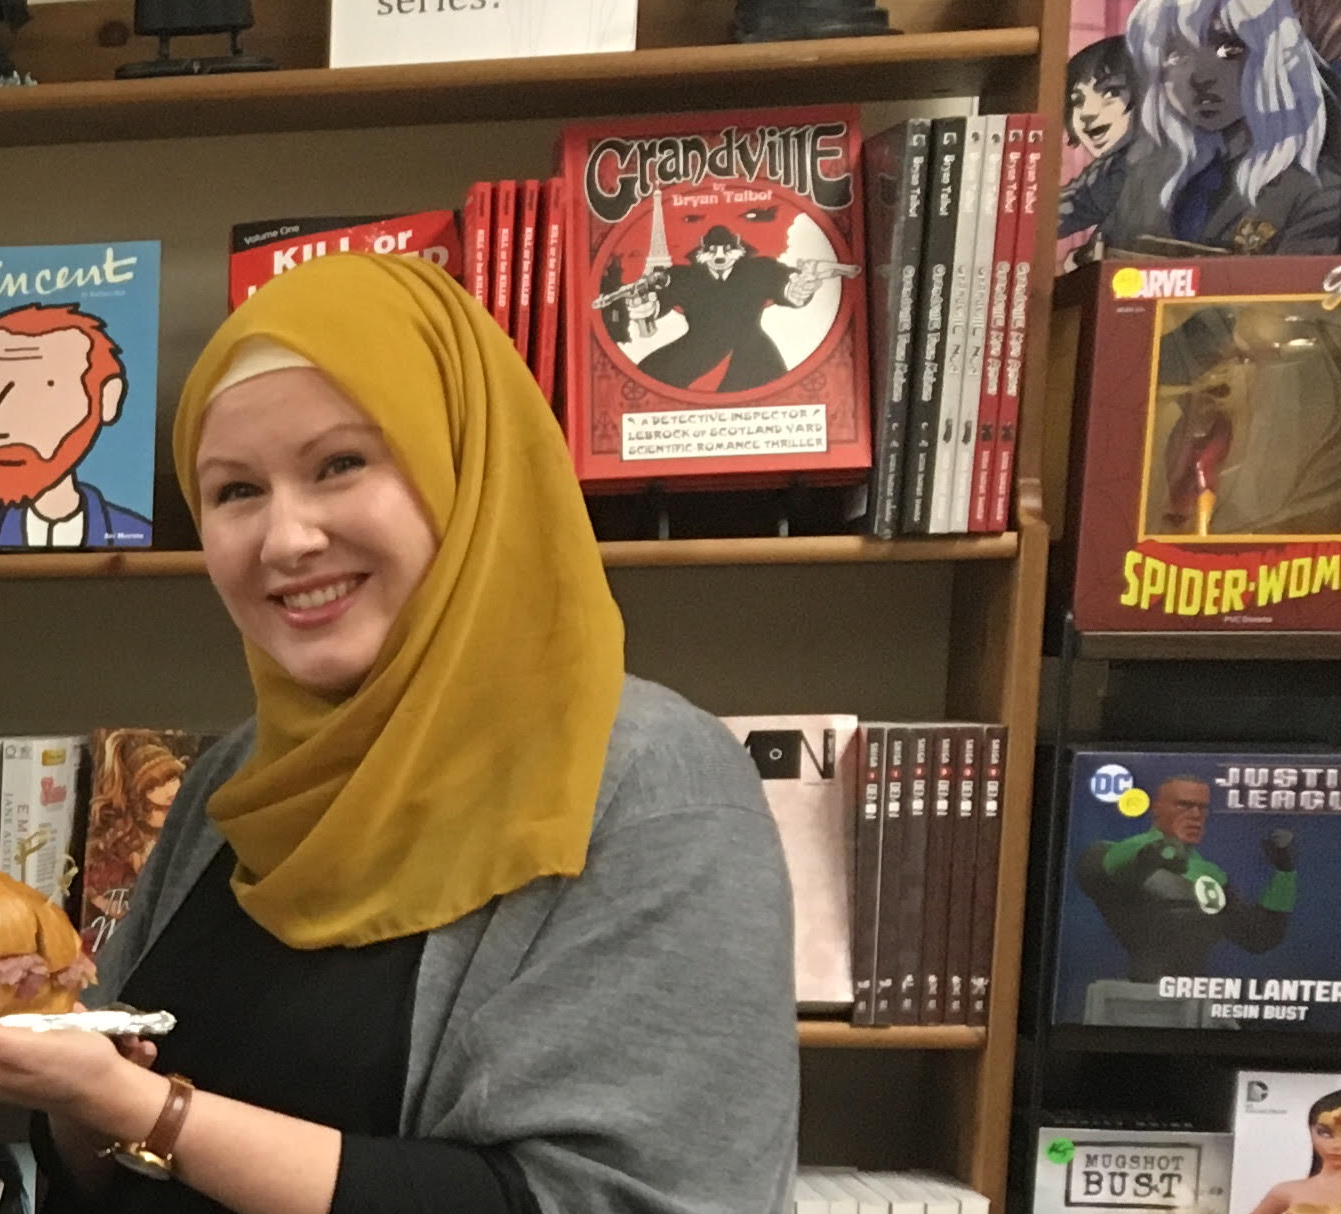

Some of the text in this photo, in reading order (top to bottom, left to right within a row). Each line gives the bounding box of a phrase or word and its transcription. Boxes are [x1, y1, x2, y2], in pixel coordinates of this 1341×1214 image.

[672, 189, 774, 208] Bryan Talbot
[280, 224, 300, 237] One
[373, 228, 413, 255] or
[1094, 773, 1132, 795] DC
[1159, 976, 1241, 999] GREEN
[1211, 1003, 1309, 1021] RESIN BUST
[1085, 1154, 1184, 1170] MUGSHOT
[1083, 1171, 1183, 1199] BUST
